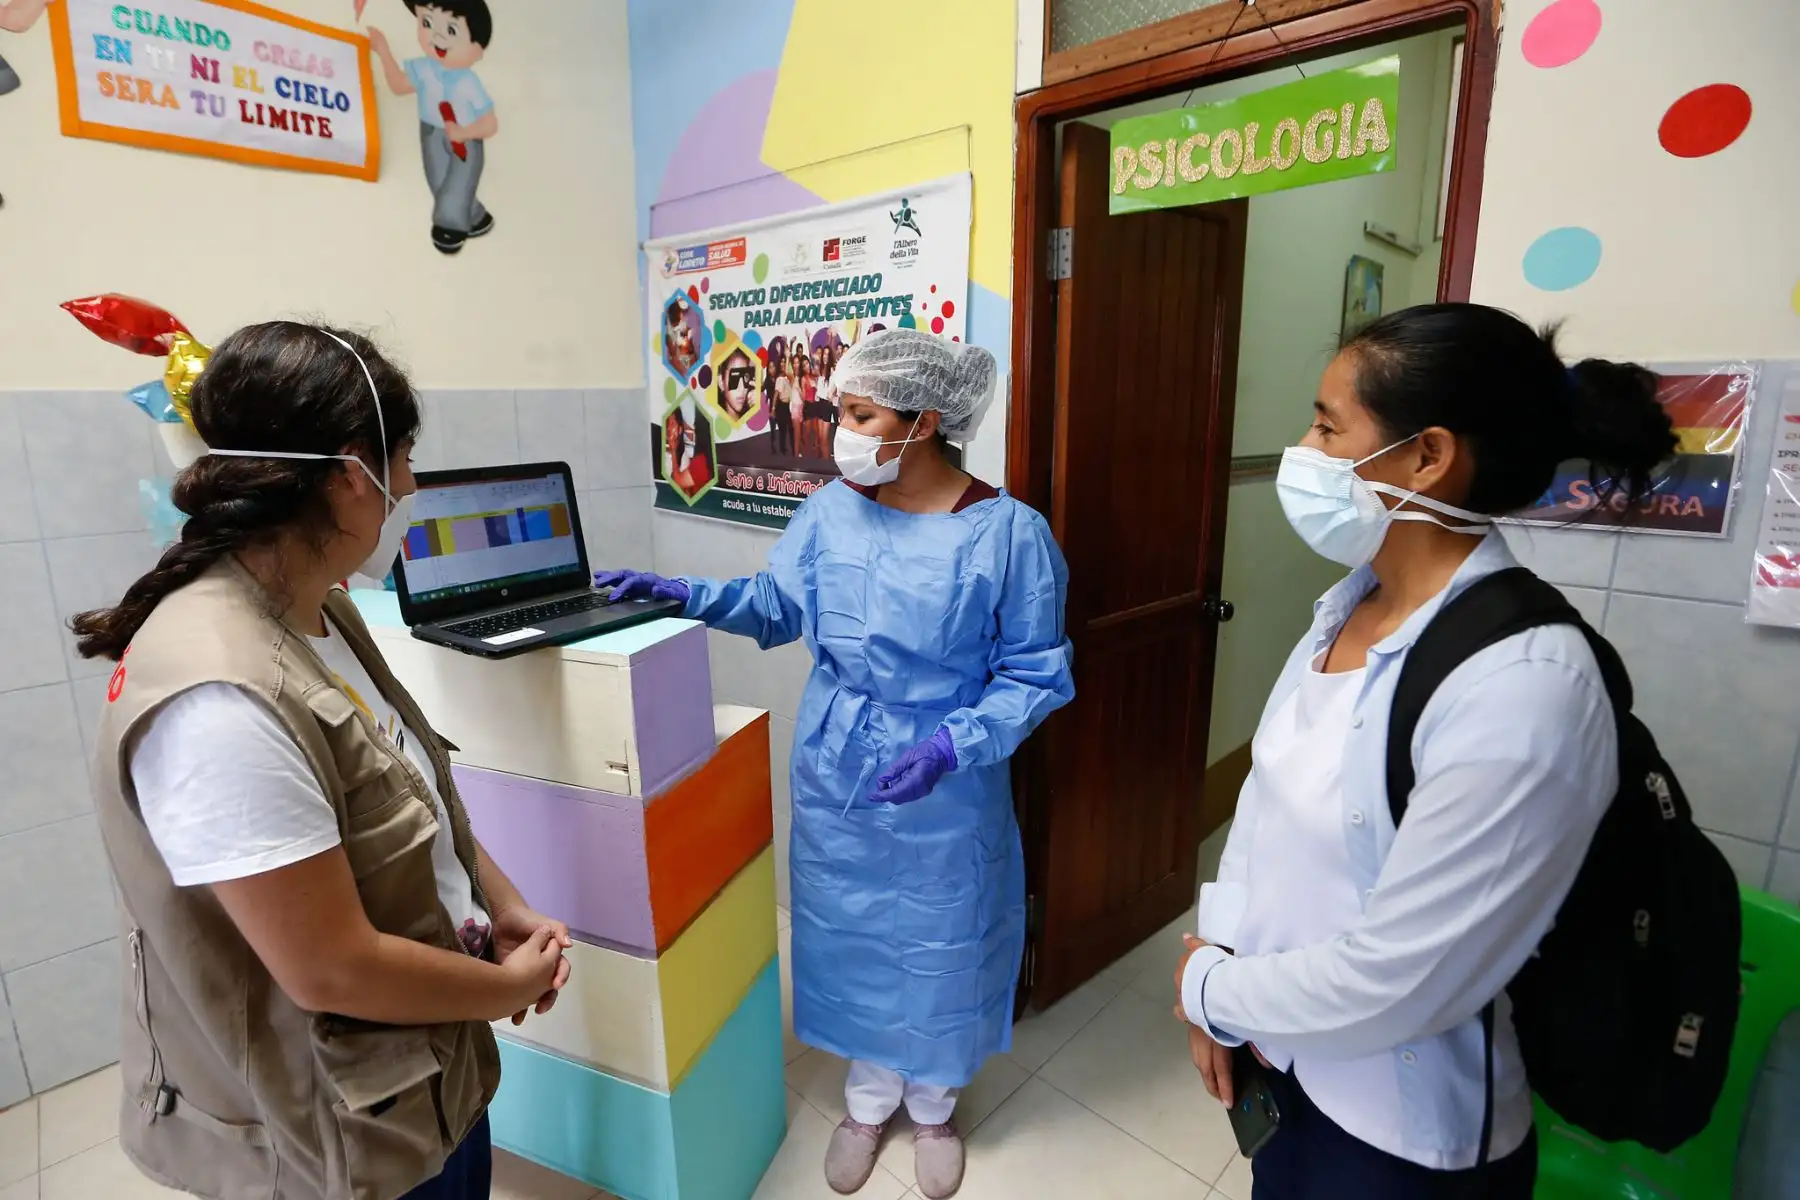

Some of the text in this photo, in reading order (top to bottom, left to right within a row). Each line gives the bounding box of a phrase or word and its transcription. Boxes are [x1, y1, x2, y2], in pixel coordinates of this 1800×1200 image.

[111, 4, 334, 78] CUANDO CREAS
[93, 33, 350, 112] EN TI NI EL CIELO
[97, 71, 333, 138] SERA TU LIMITE
[1113, 97, 1391, 195] PSICOLOGIA
[708, 248, 731, 260] SALUD
[842, 235, 867, 246] FORGE
[680, 256, 705, 269] LORETO
[708, 272, 882, 310] SERVICIO DIFERENCIADO
[744, 294, 914, 328] PARA ADOLESCENTES
[726, 469, 754, 489] Sano
[756, 476, 764, 491] e
[723, 499, 745, 511] acude
[746, 503, 752, 512] a
[752, 502, 761, 513] tu
